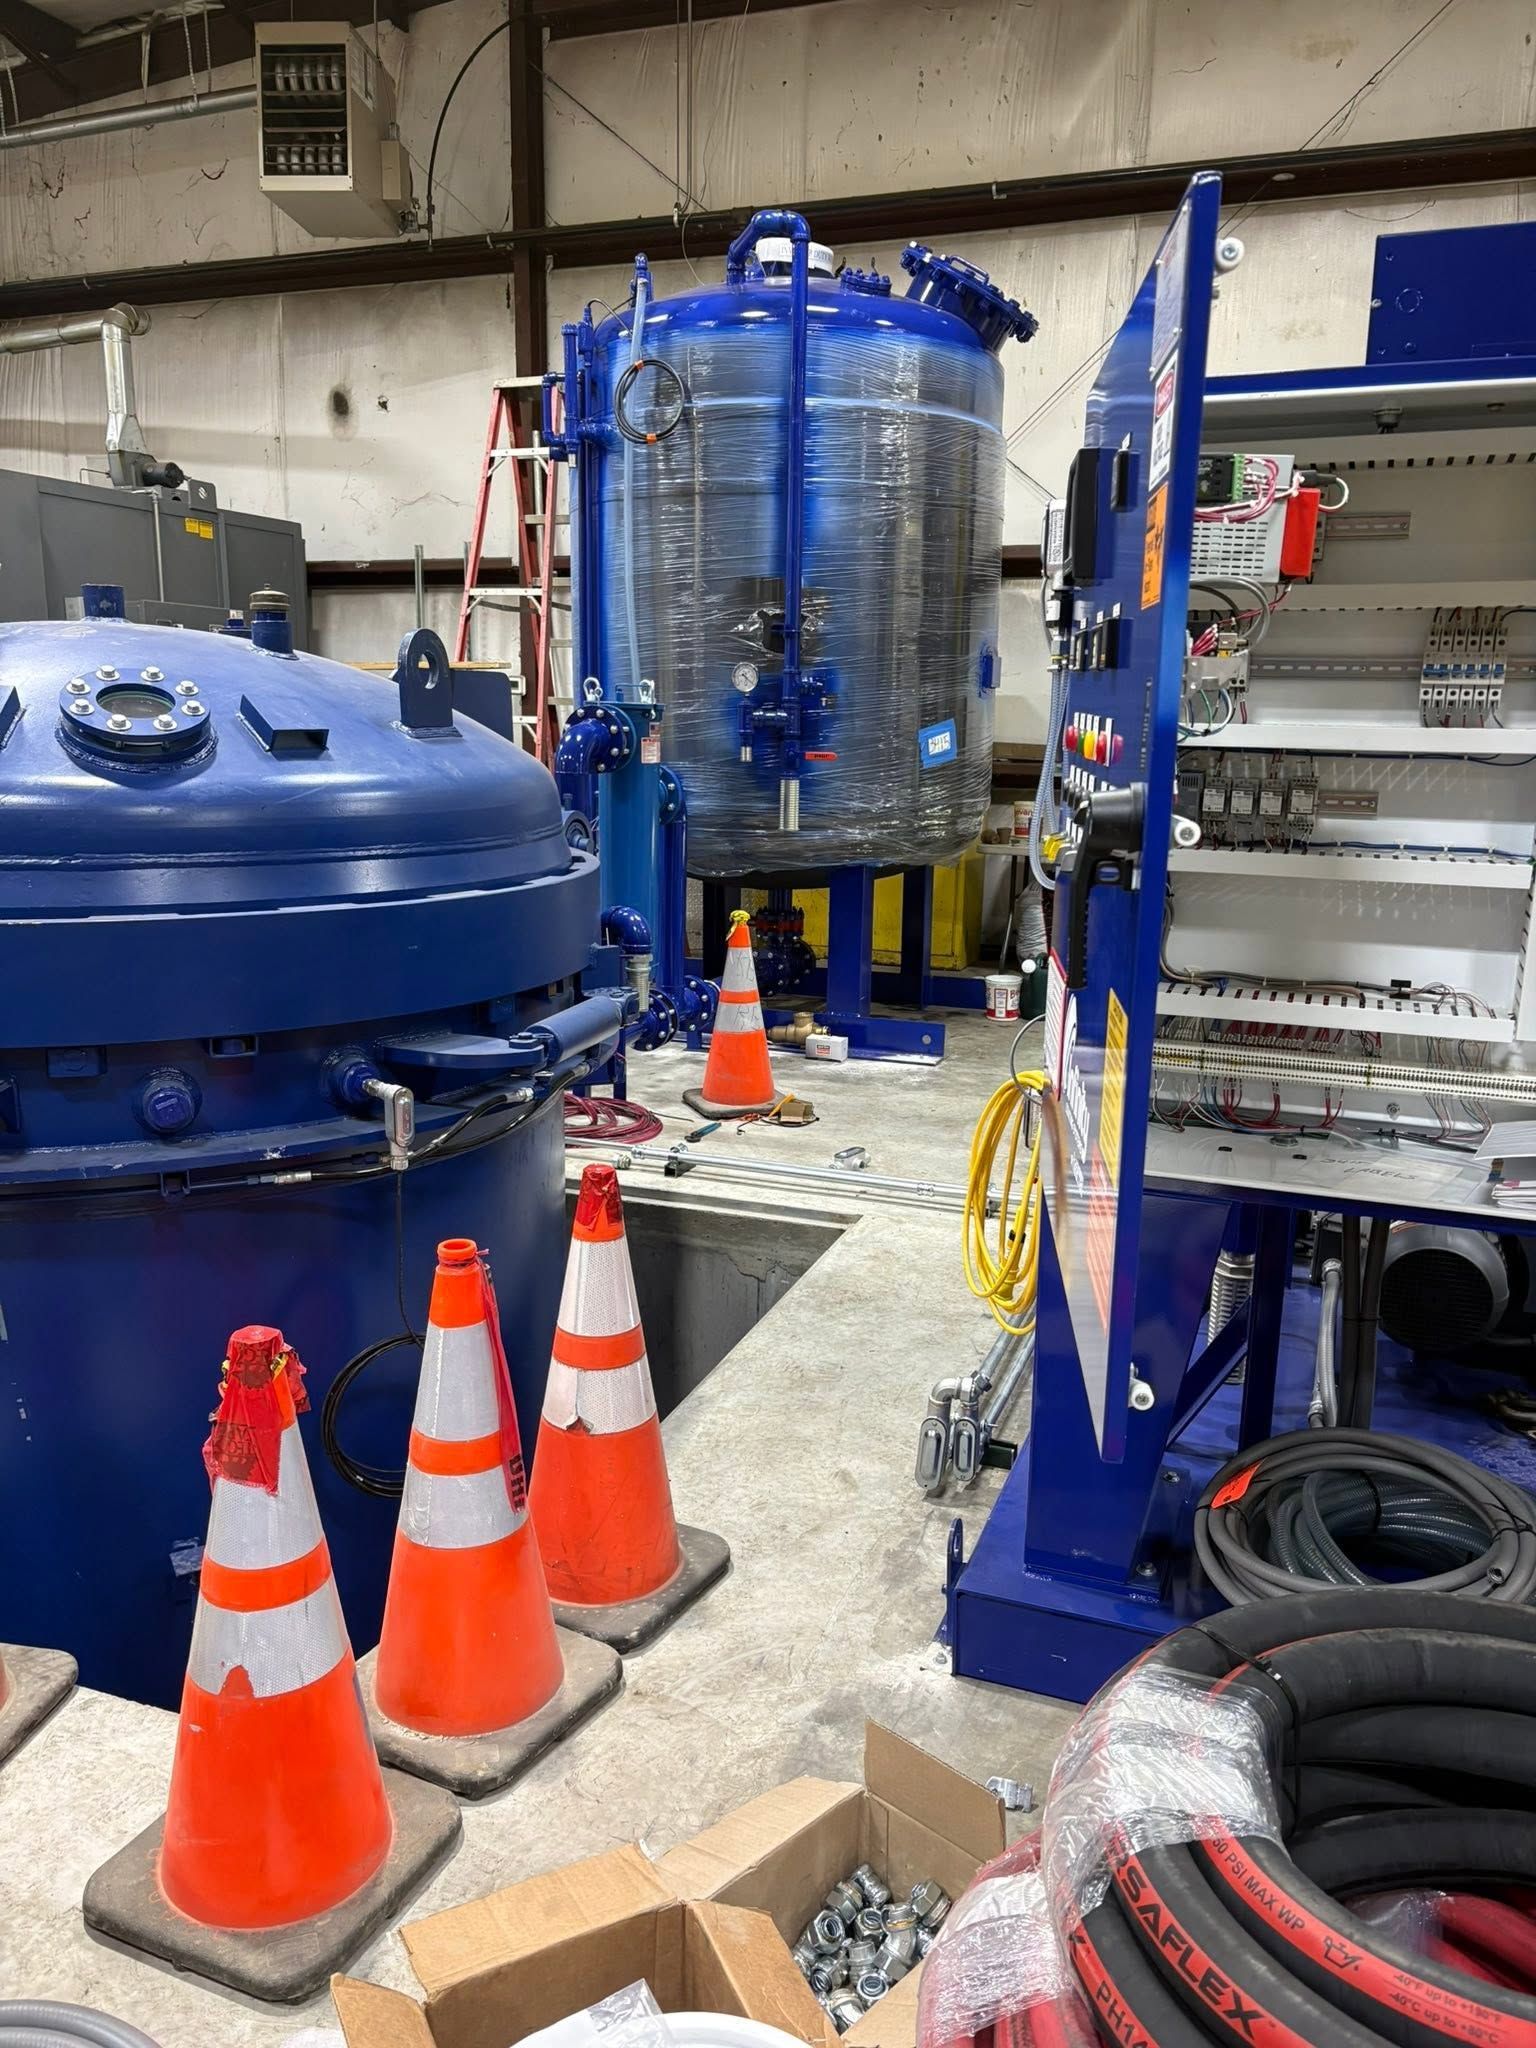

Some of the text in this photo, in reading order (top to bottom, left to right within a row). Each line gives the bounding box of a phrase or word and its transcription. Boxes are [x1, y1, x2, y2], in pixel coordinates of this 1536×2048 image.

[1224, 1852, 1248, 1879] PSI
[1244, 1875, 1277, 1911] MAX
[1277, 1904, 1306, 1930] WP
[1095, 1980, 1149, 2048] PH1
[1424, 2008, 1441, 2023] up
[1443, 2016, 1457, 2028] to
[1425, 1988, 1442, 2001] up
[1444, 1995, 1457, 2007] to
